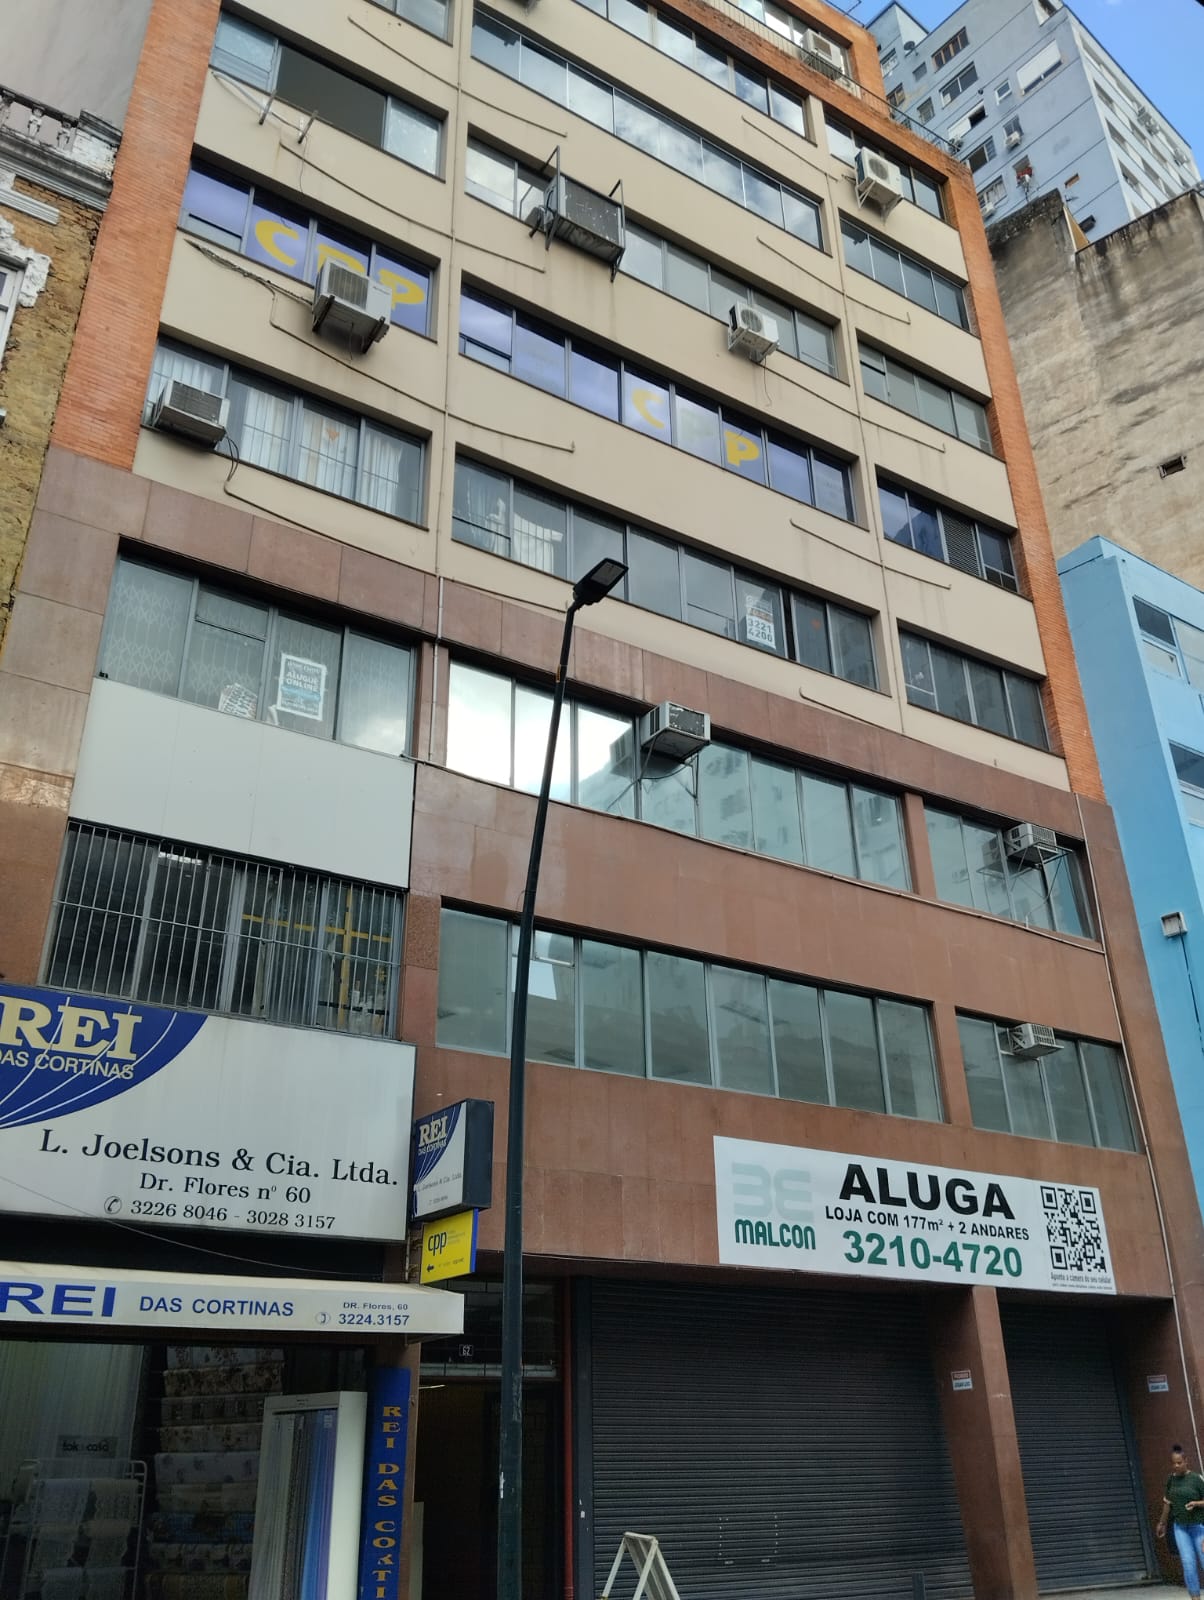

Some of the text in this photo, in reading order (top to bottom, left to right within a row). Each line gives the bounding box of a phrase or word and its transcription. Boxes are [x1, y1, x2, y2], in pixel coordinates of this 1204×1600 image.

[0, 996, 142, 1060] REI
[0, 1049, 134, 1080] AS CORTINAS
[419, 1116, 448, 1147] REI
[40, 1129, 398, 1185] L. Joelsons & Cia. Ltda.
[140, 1172, 173, 1191] Dr.
[184, 1177, 249, 1198] Flores
[286, 1186, 311, 1203] 60
[839, 1163, 1016, 1220] ALUGA
[131, 1200, 177, 1217] 3226
[183, 1204, 227, 1221] 8046
[246, 1210, 289, 1226] 3028
[294, 1213, 336, 1229] 3157
[825, 1205, 863, 1223] LOJA
[867, 1210, 899, 1227] COM
[948, 1221, 955, 1231] +
[959, 1221, 967, 1234] 2
[971, 1223, 1030, 1241] ANDARES
[428, 1231, 447, 1257] cpp
[734, 1219, 816, 1250] MALCON
[842, 1230, 1022, 1278] 3210-4720
[0, 1282, 294, 1317] REI DAS CORTINAS
[338, 1313, 410, 1326] 3224.3157
[382, 1406, 402, 1448] REI
[376, 1463, 399, 1507] DAS
